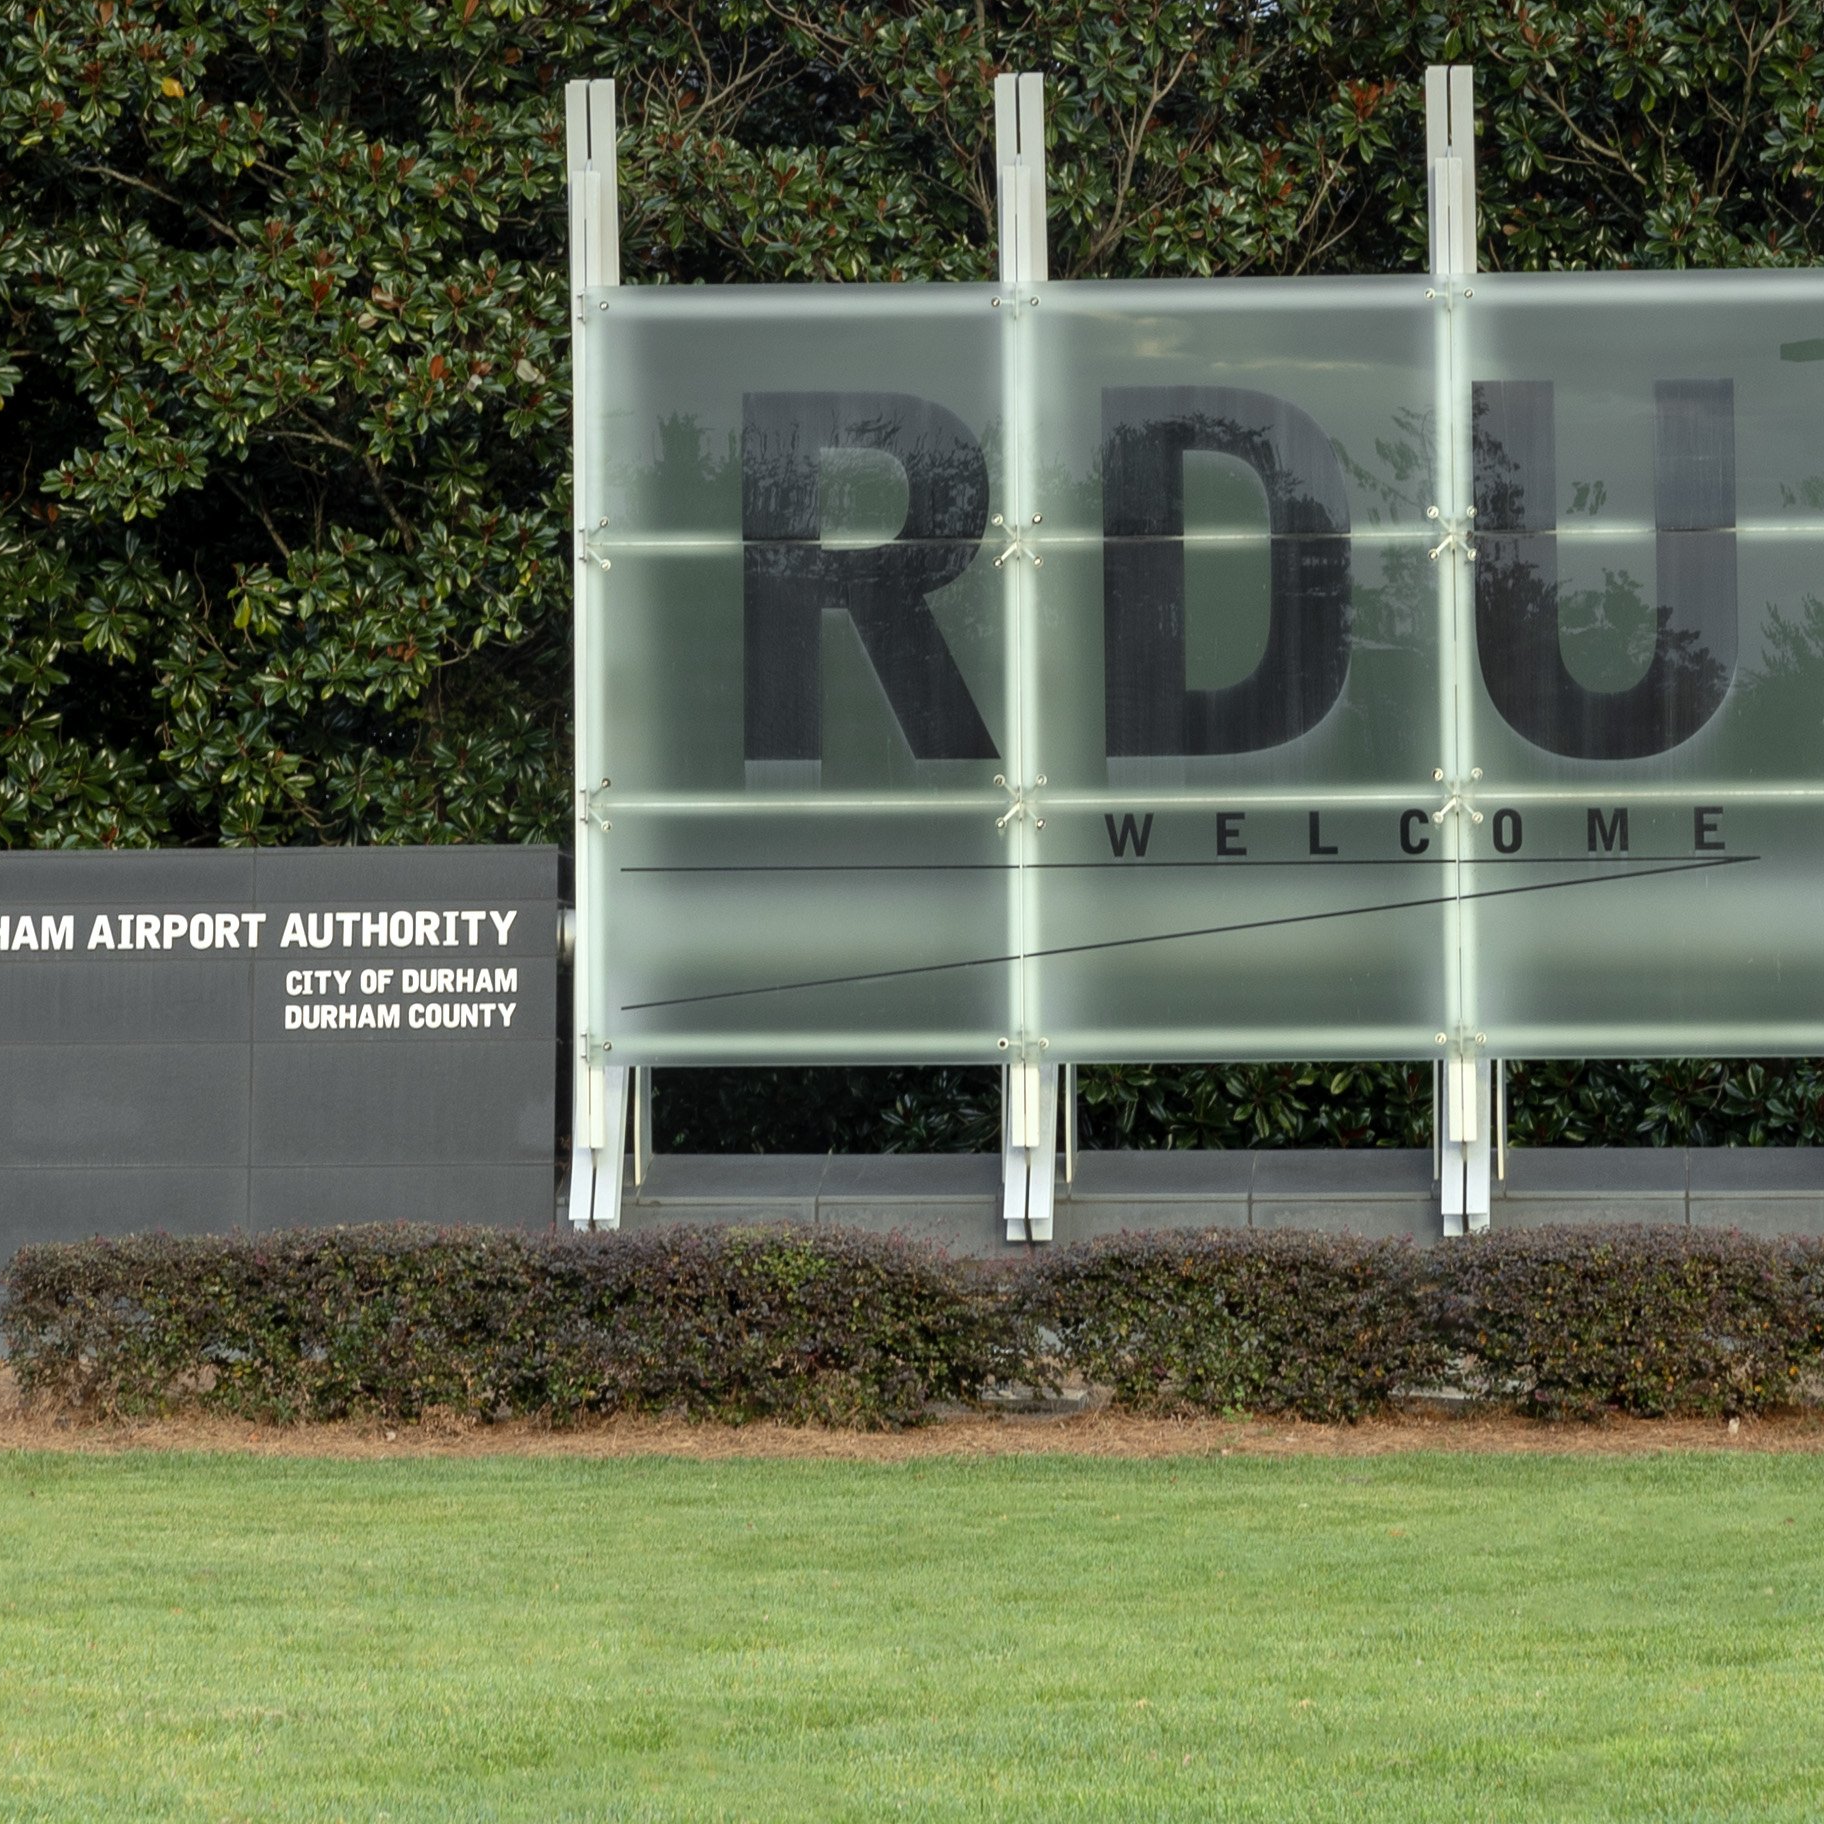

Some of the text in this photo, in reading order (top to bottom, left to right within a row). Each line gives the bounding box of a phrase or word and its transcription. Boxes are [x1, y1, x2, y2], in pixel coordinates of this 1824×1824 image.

[740, 378, 1739, 762] RDU
[1103, 805, 1727, 859] WELCOME
[86, 911, 268, 951] AIRPORT
[278, 909, 519, 949] AUTHORITY
[284, 966, 519, 997] CITY OF DURHAM
[283, 1001, 518, 1031] DURHAM COUNTY
